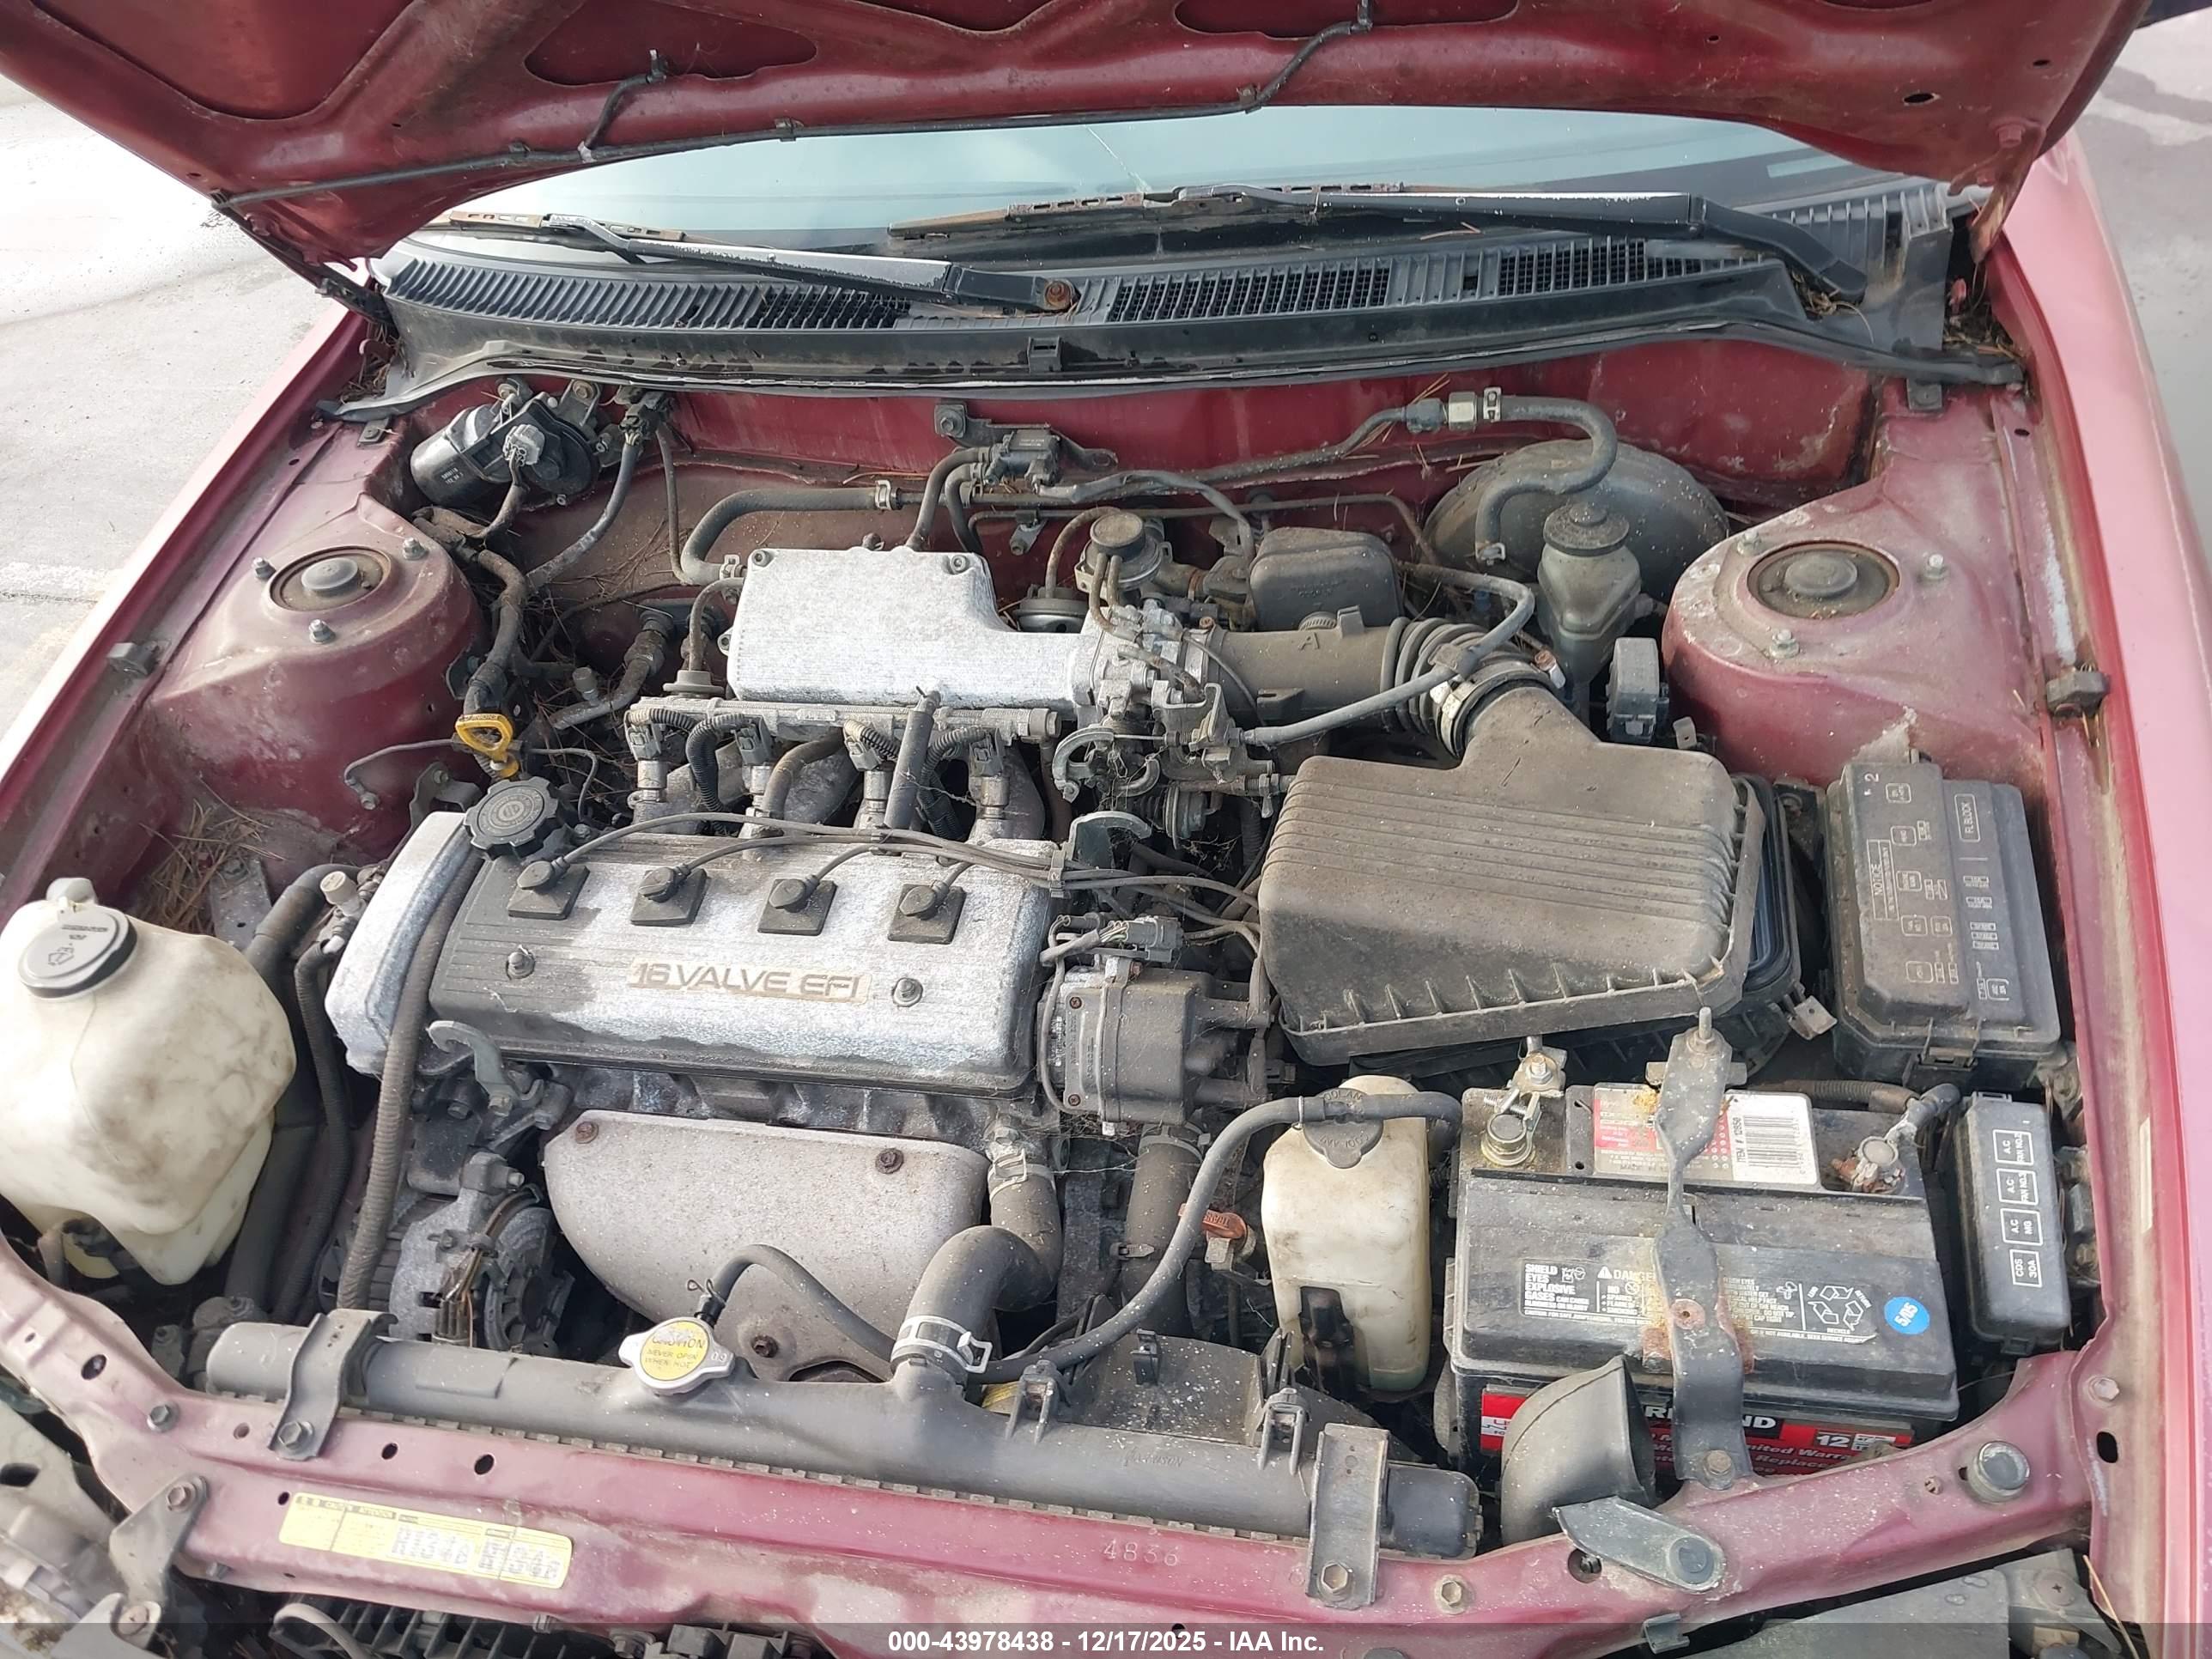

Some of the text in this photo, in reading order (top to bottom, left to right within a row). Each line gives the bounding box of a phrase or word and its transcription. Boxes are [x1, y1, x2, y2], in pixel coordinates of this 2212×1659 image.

[1864, 773, 1879, 782] 2
[1871, 864, 1883, 896] NOTICE
[633, 963, 859, 998] 16 VALVE EFI
[1736, 1147, 1746, 1163] ITEM
[2015, 1149, 2027, 1164] FAN
[2020, 1188, 2030, 1203] FAN
[1524, 1263, 1559, 1275] SHIELD
[1613, 1269, 1653, 1281] DANGE
[2014, 1258, 2024, 1278] CDS
[2028, 1260, 2038, 1279] 30A
[1524, 1273, 1550, 1284] EYES
[1524, 1282, 1577, 1295] EXPLOSIVE
[1607, 1285, 1620, 1294] NO
[1524, 1291, 1555, 1302] GASES
[1854, 1290, 1873, 1310] RETURN
[1893, 1302, 1918, 1327] 5/05
[653, 1334, 706, 1349] CAUTION
[647, 1349, 674, 1358] NEVER
[645, 1358, 669, 1367] WHEN
[1816, 1433, 1850, 1448] 12
